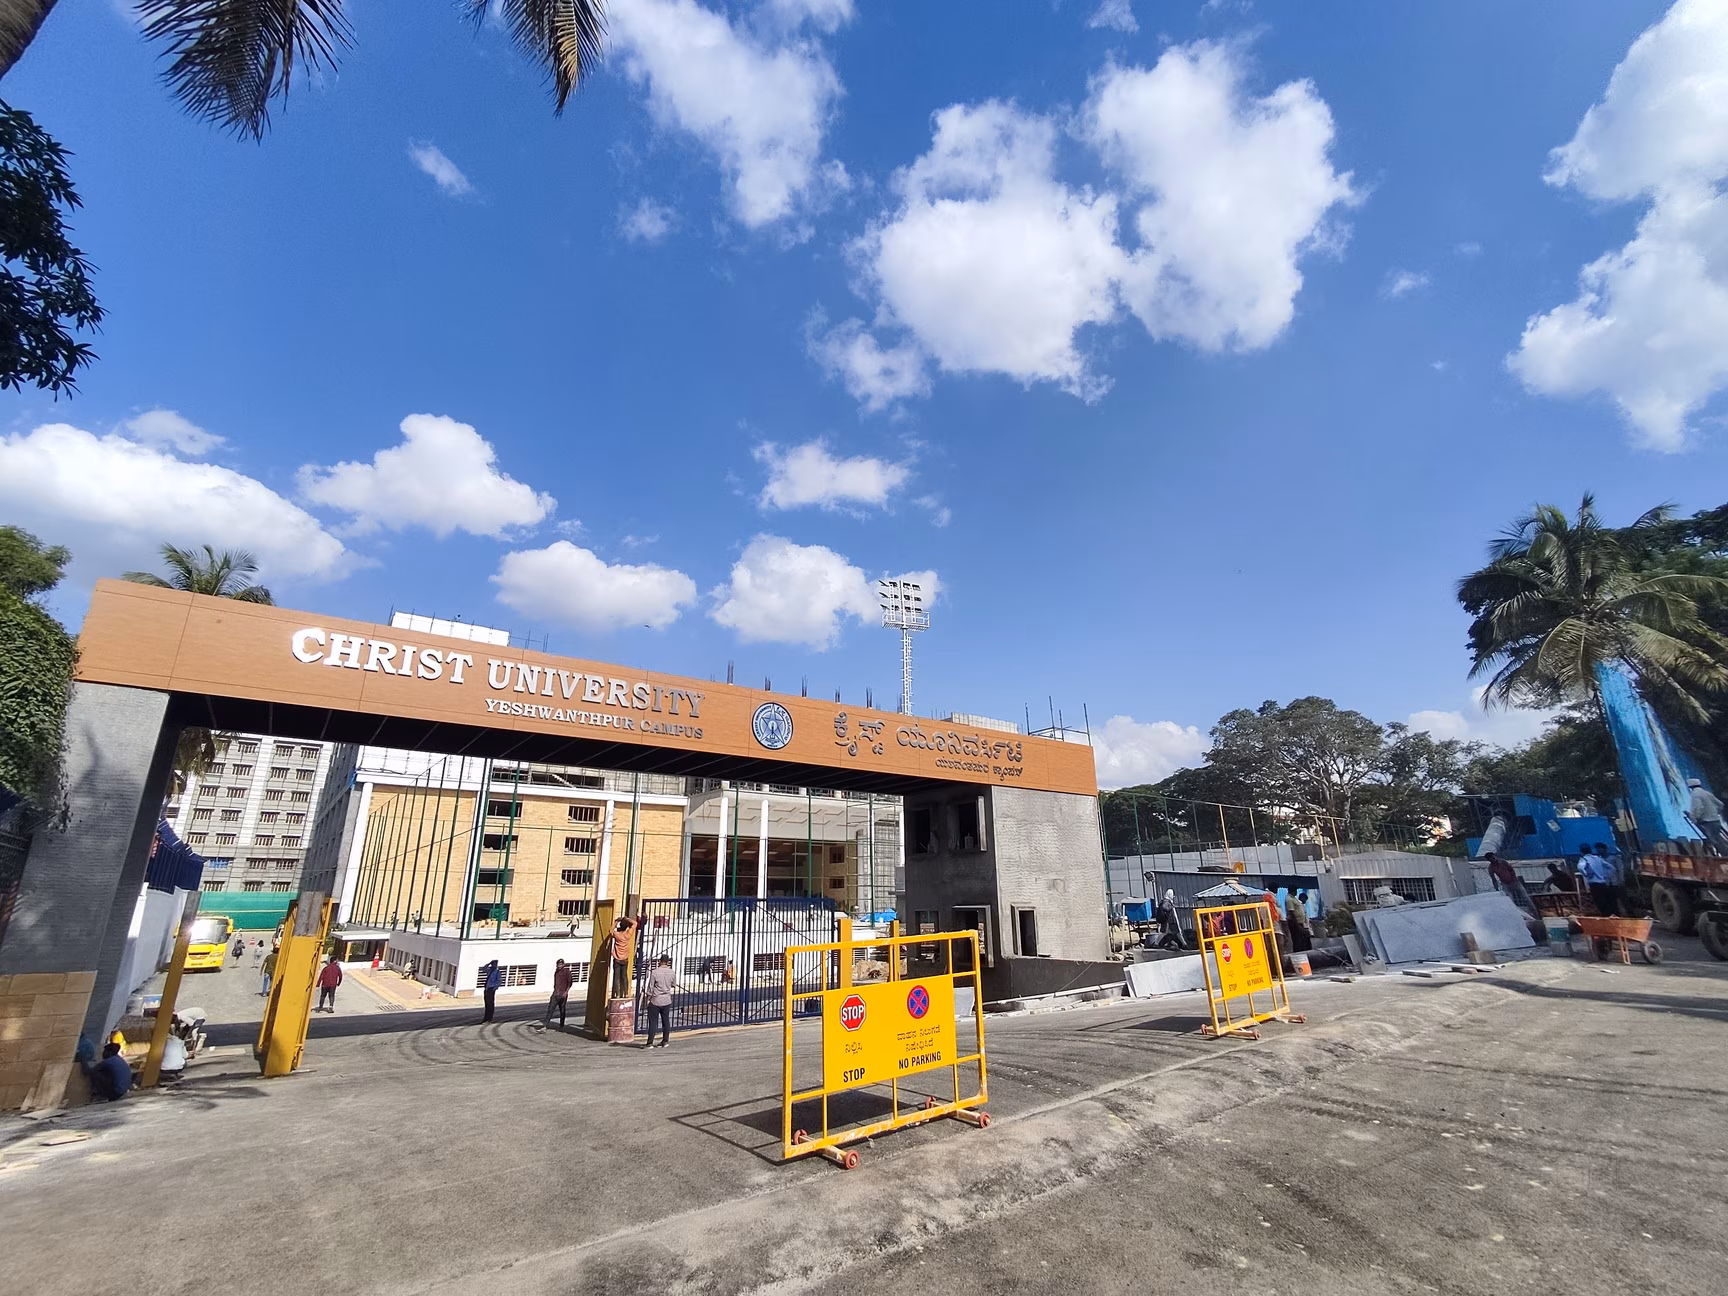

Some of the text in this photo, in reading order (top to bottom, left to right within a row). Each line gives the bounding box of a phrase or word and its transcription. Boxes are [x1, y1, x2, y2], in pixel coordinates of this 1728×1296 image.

[291, 627, 706, 719] CHRIST UNIVERSITY
[485, 698, 704, 740] YESHWANTHPUR CAMPUS
[842, 1004, 865, 1022] STOP
[898, 1051, 942, 1070] NO PARKING
[843, 1067, 866, 1083] STOP
